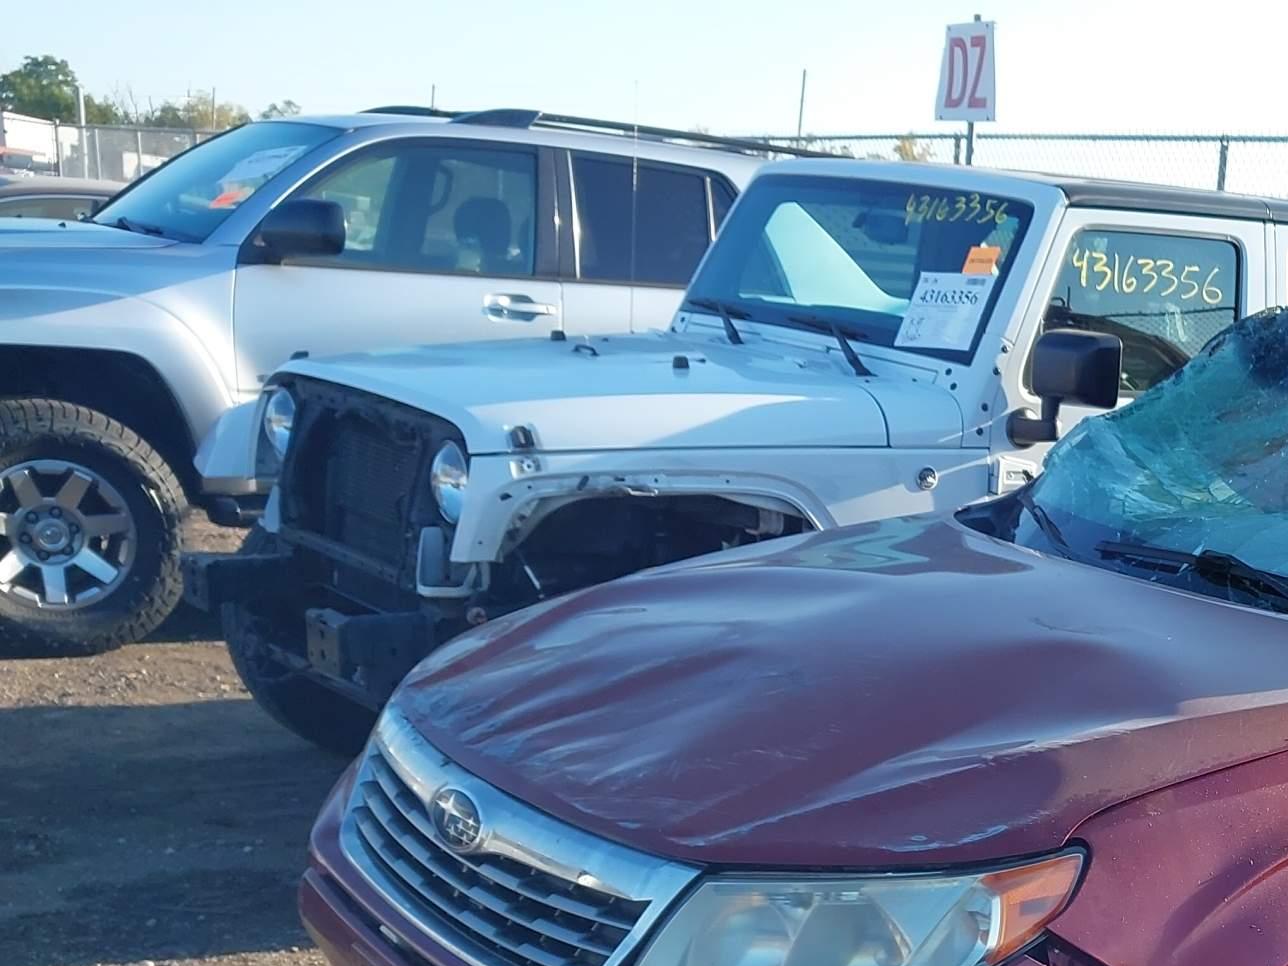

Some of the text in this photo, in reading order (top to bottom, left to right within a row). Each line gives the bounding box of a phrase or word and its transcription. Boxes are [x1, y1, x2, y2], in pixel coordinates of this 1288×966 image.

[943, 35, 988, 109] DZ
[904, 193, 1009, 226] 43163356
[919, 289, 979, 306] 43163356
[1072, 247, 1223, 305] 43163356
